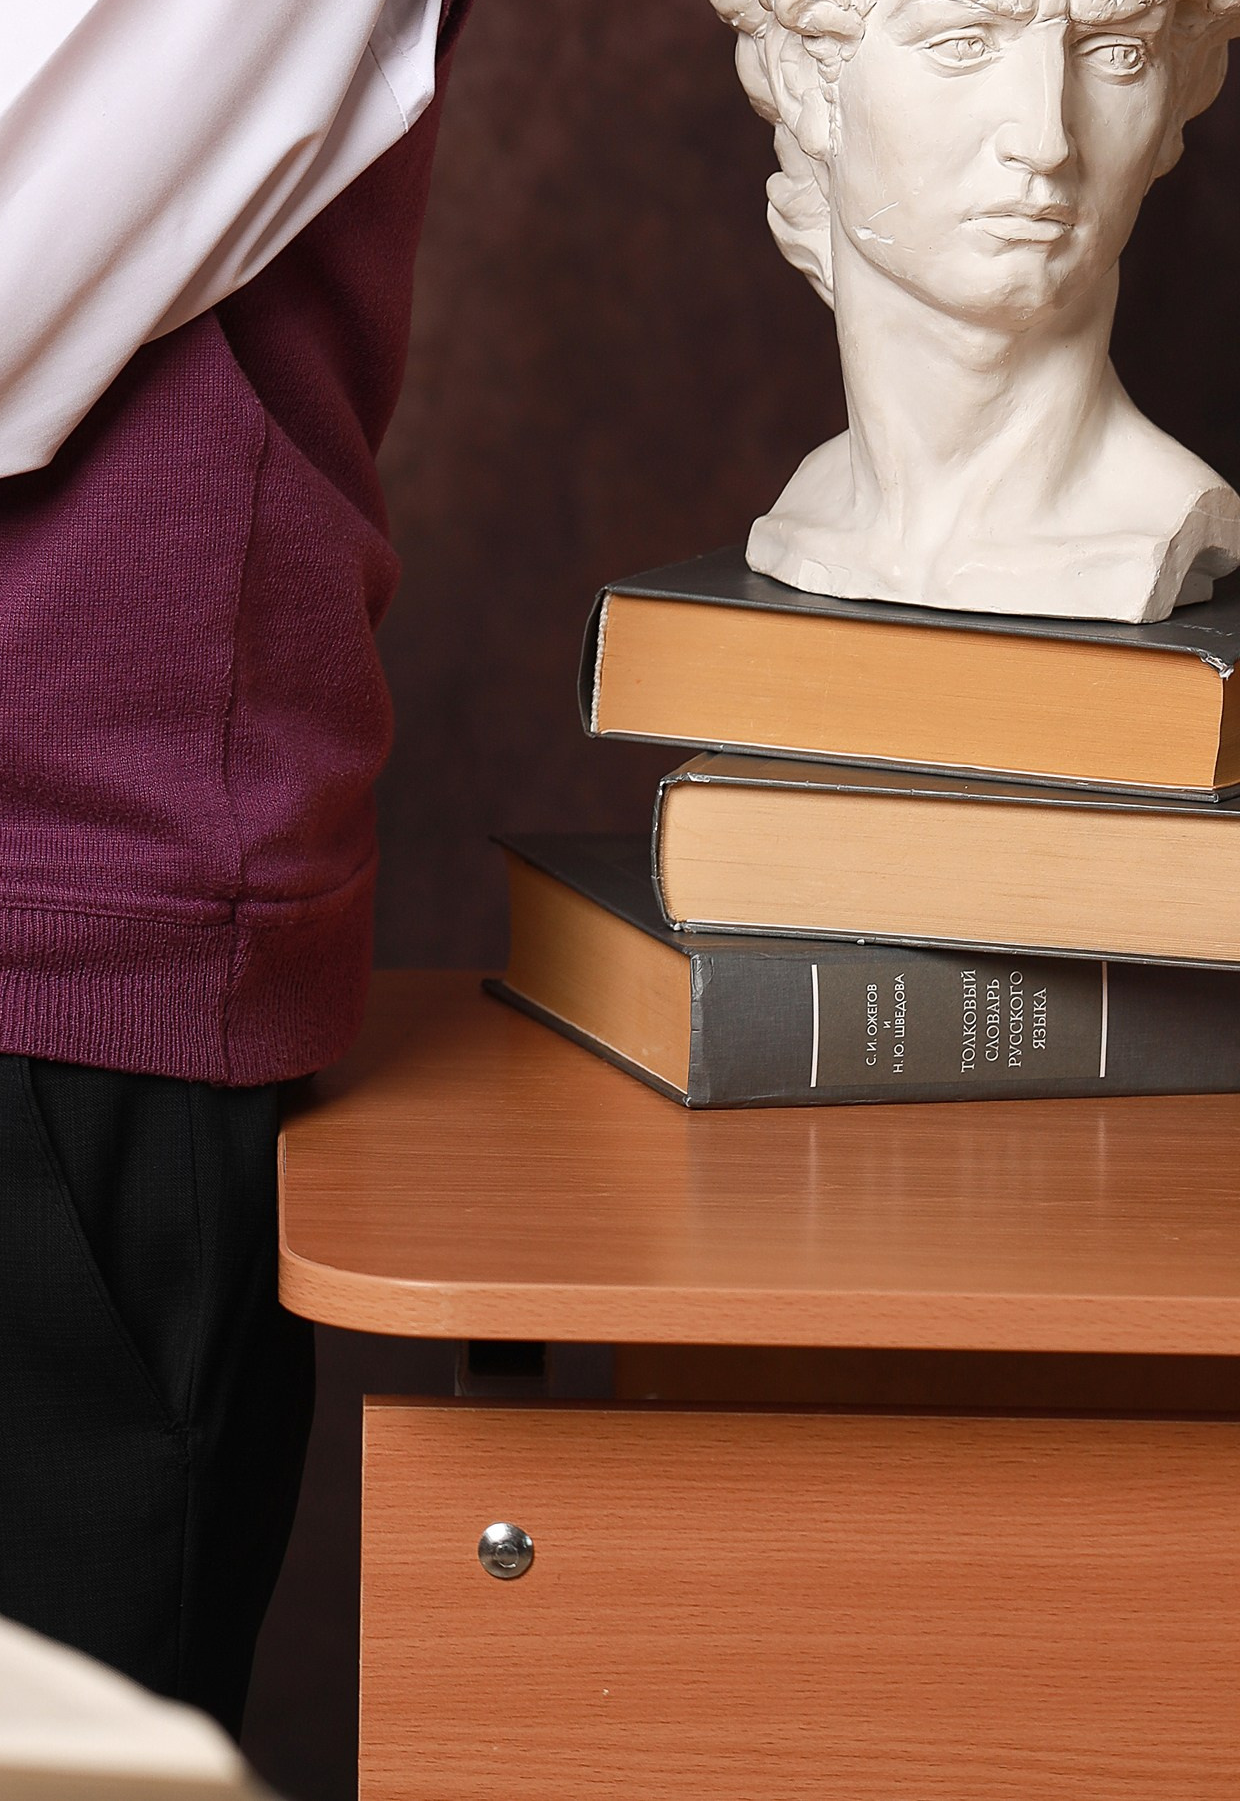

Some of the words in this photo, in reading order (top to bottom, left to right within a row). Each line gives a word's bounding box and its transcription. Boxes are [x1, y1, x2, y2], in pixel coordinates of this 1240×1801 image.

[866, 983, 878, 1036] ОЖЕГОВ
[894, 972, 907, 1038] ШВЕДОВА
[960, 969, 977, 1073] ТОЛКОВЫЙ
[985, 978, 1001, 1062] СЛОВАРЬ
[1007, 971, 1024, 1068] РУССКОГО
[1032, 987, 1047, 1050] ЯЗЫКА
[865, 1053, 878, 1066] С.
[866, 1038, 878, 1052] И.
[893, 1059, 904, 1073] Н.
[894, 1040, 905, 1058] Ю.
